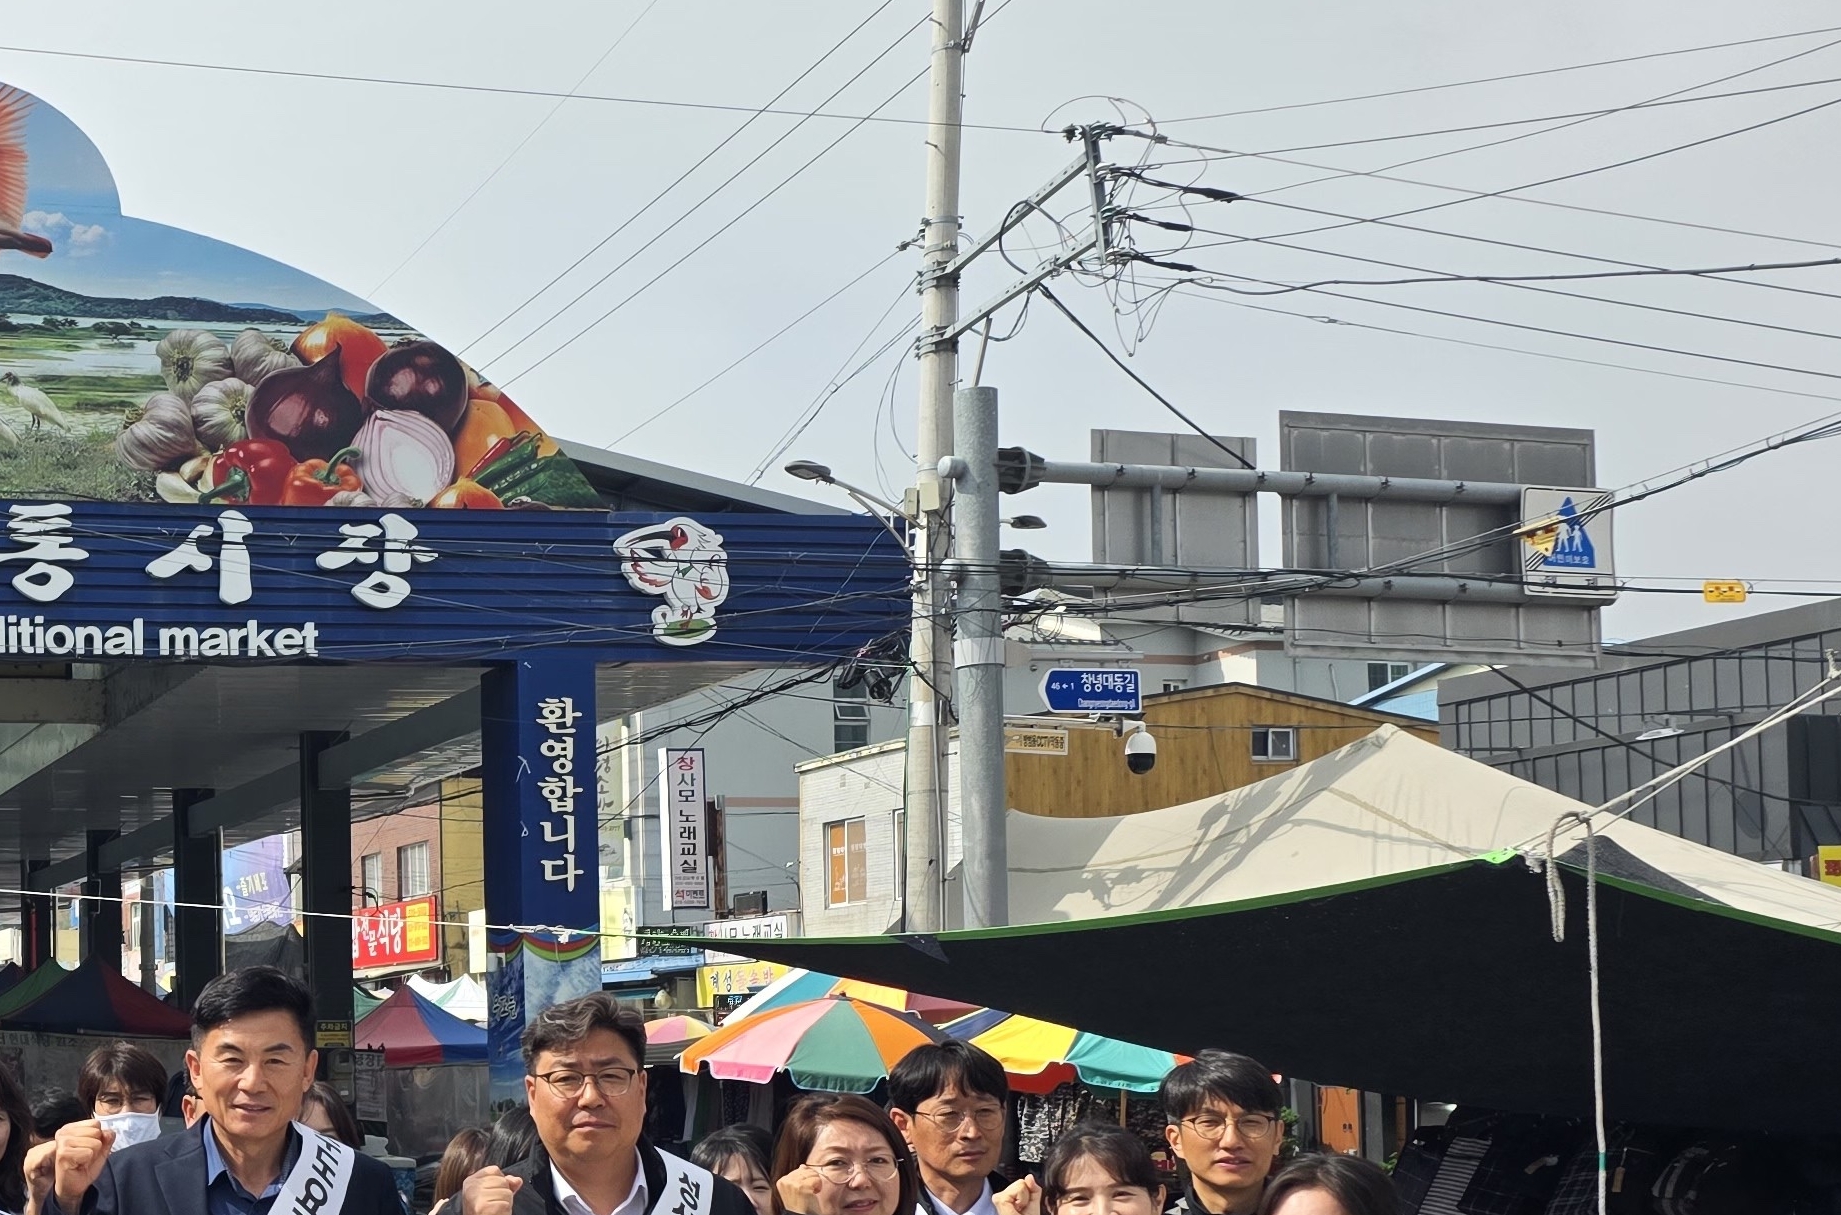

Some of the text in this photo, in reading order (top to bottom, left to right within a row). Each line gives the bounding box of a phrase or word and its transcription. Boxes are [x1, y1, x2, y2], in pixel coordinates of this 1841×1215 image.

[159, 619, 319, 658] market
[1051, 682, 1060, 690] 46
[1081, 673, 1135, 692] 창녕대동길
[536, 697, 584, 893] 환영합니다
[679, 810, 697, 874] 노래교실
